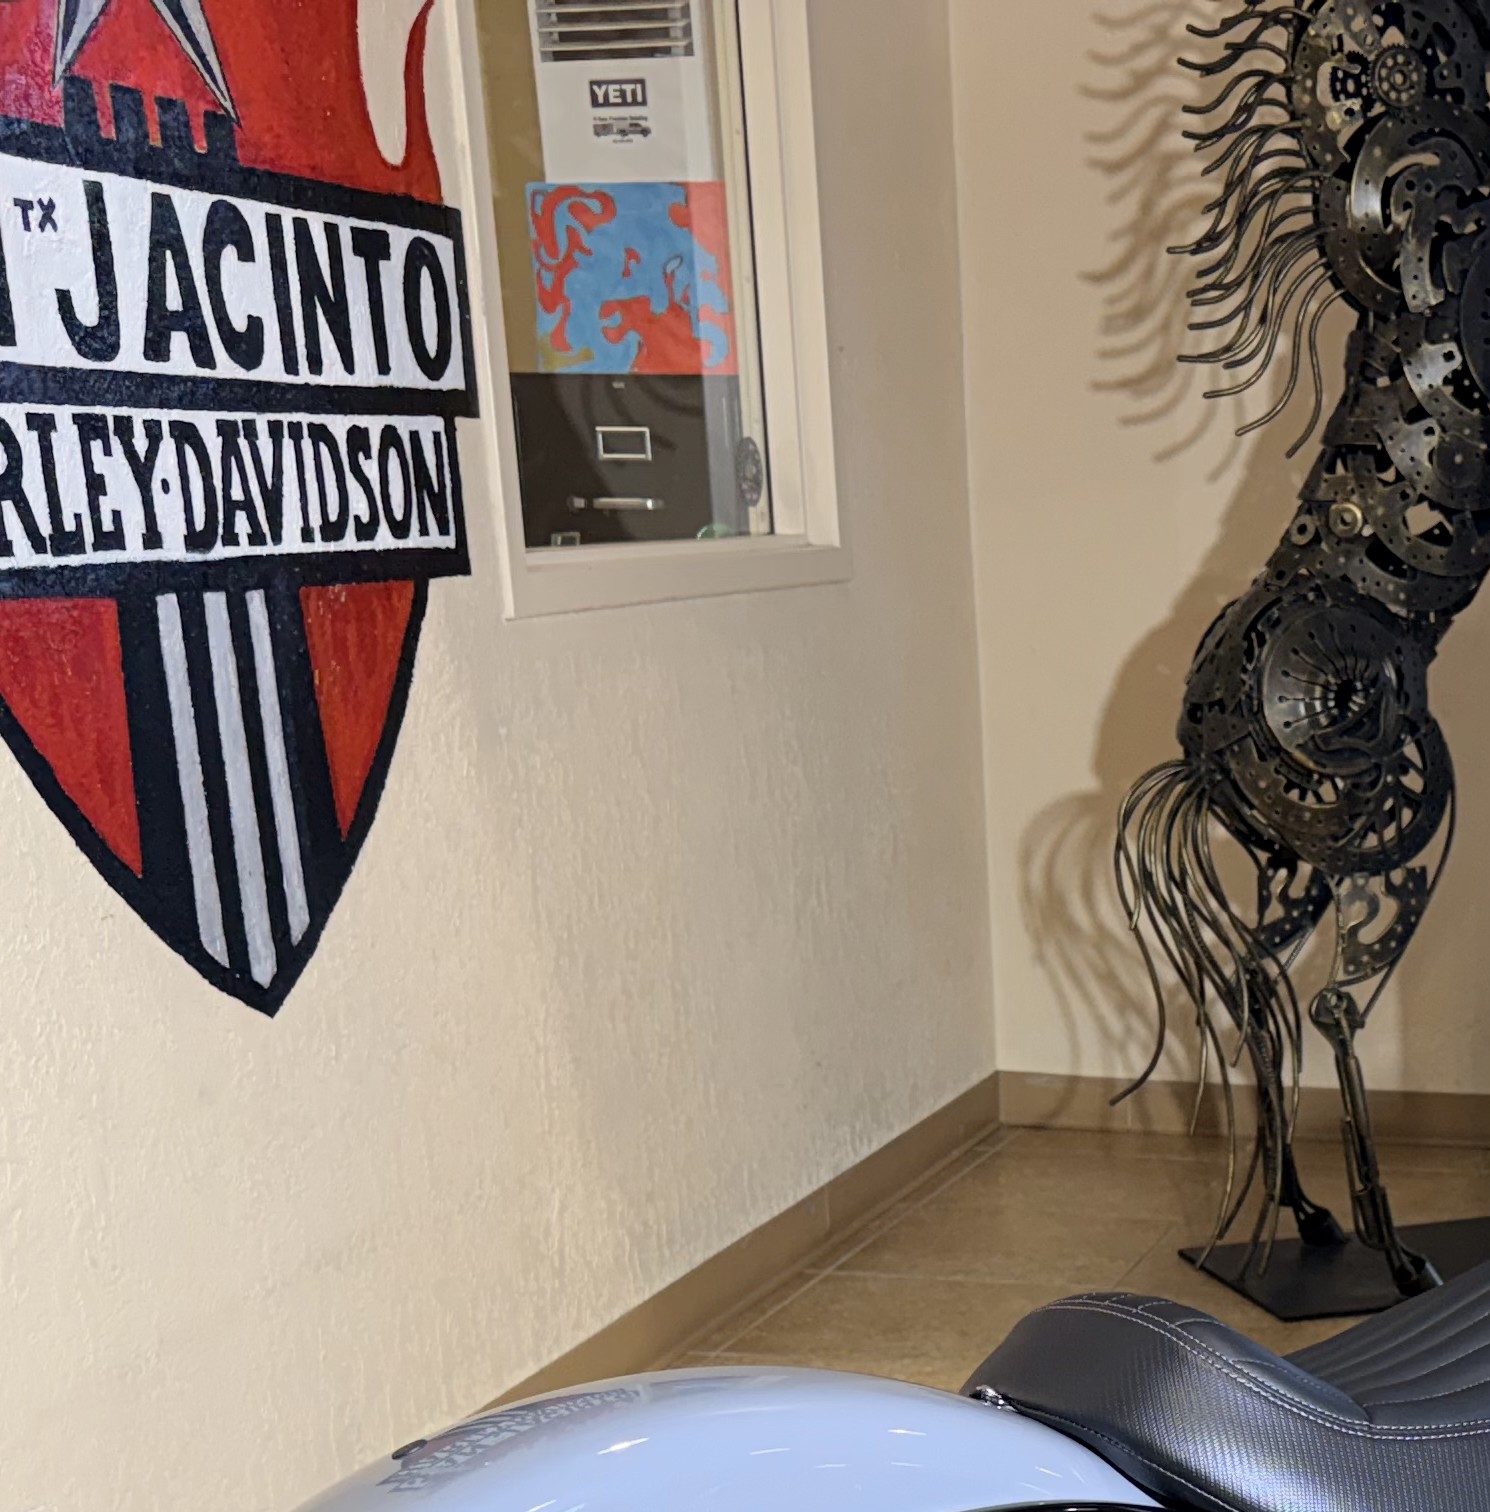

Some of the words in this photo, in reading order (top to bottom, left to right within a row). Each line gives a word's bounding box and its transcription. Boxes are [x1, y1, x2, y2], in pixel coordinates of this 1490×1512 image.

[592, 83, 643, 104] YETI
[13, 196, 58, 233] TX
[55, 179, 453, 382] JACINTO
